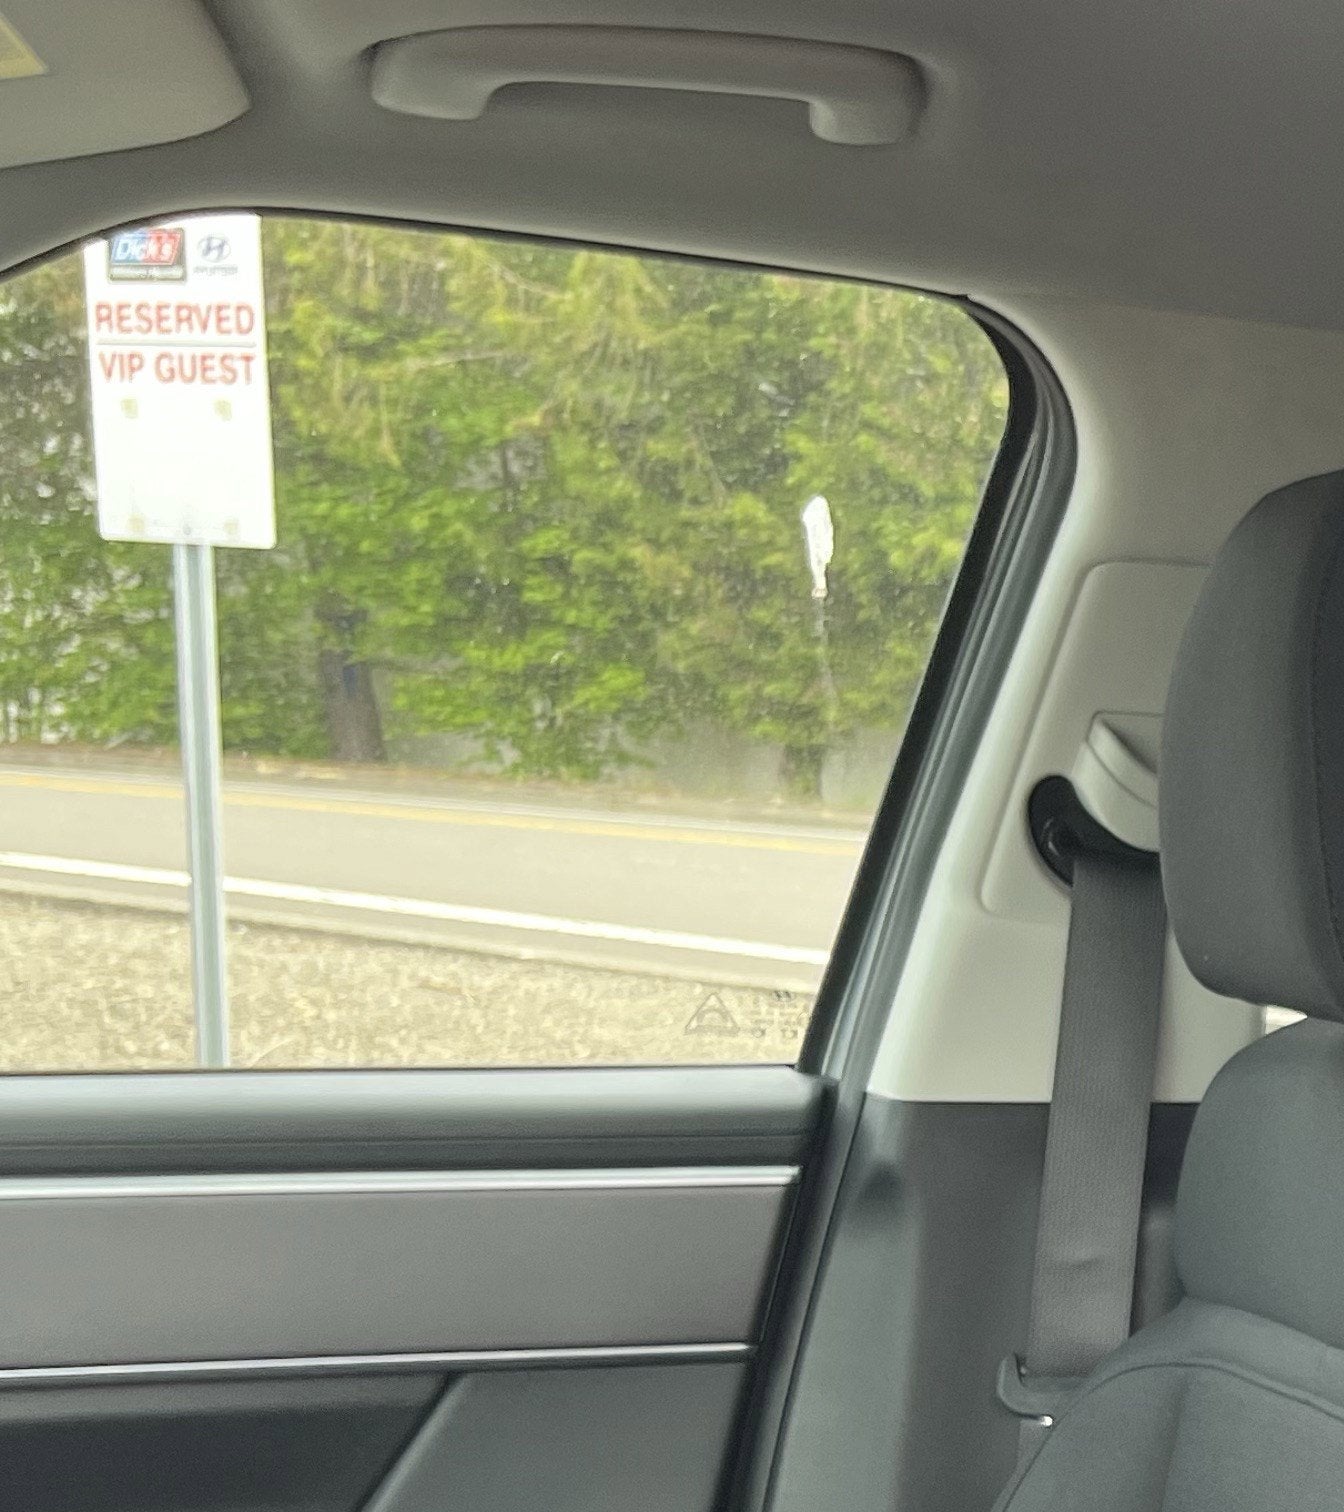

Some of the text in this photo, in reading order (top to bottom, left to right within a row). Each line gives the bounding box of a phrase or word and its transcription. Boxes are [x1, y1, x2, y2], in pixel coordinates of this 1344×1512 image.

[94, 301, 256, 335] RESERVED
[98, 350, 257, 386] VIP GUEST
